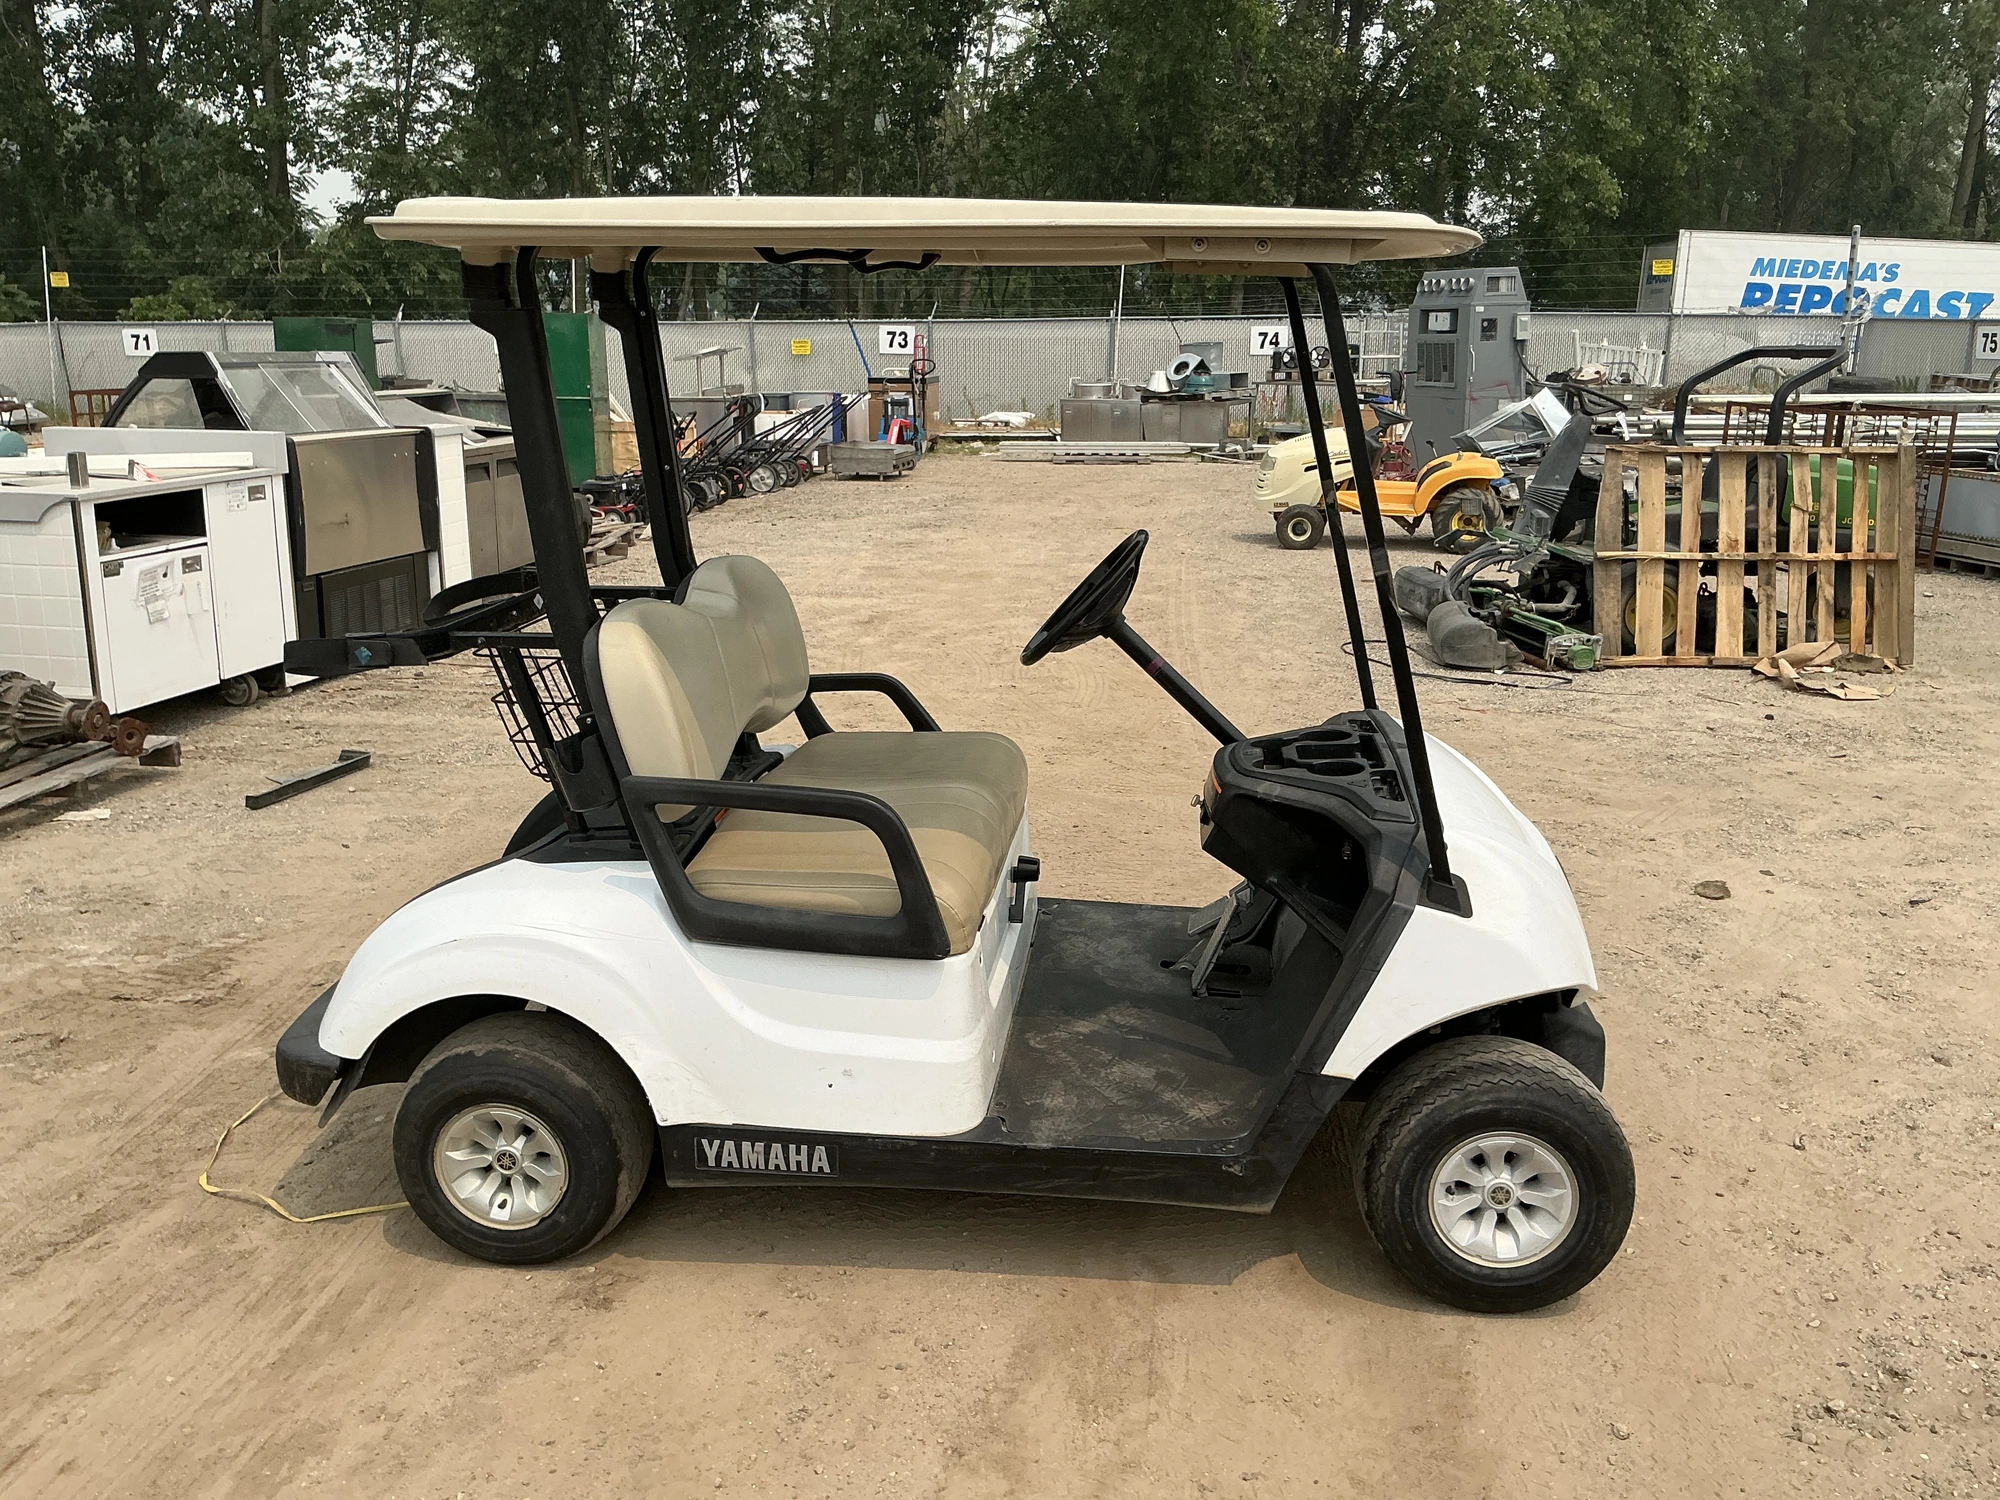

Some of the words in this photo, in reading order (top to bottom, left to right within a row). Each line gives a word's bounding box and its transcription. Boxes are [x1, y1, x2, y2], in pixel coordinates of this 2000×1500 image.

[1750, 258, 1900, 282] MIEDEMA'S
[1740, 282, 1994, 318] REPOCAST
[130, 334, 151, 351] 71
[886, 331, 908, 349] 73
[1258, 332, 1280, 349] 74
[1982, 333, 1998, 353] 75
[701, 1138, 831, 1174] YAMAHA
